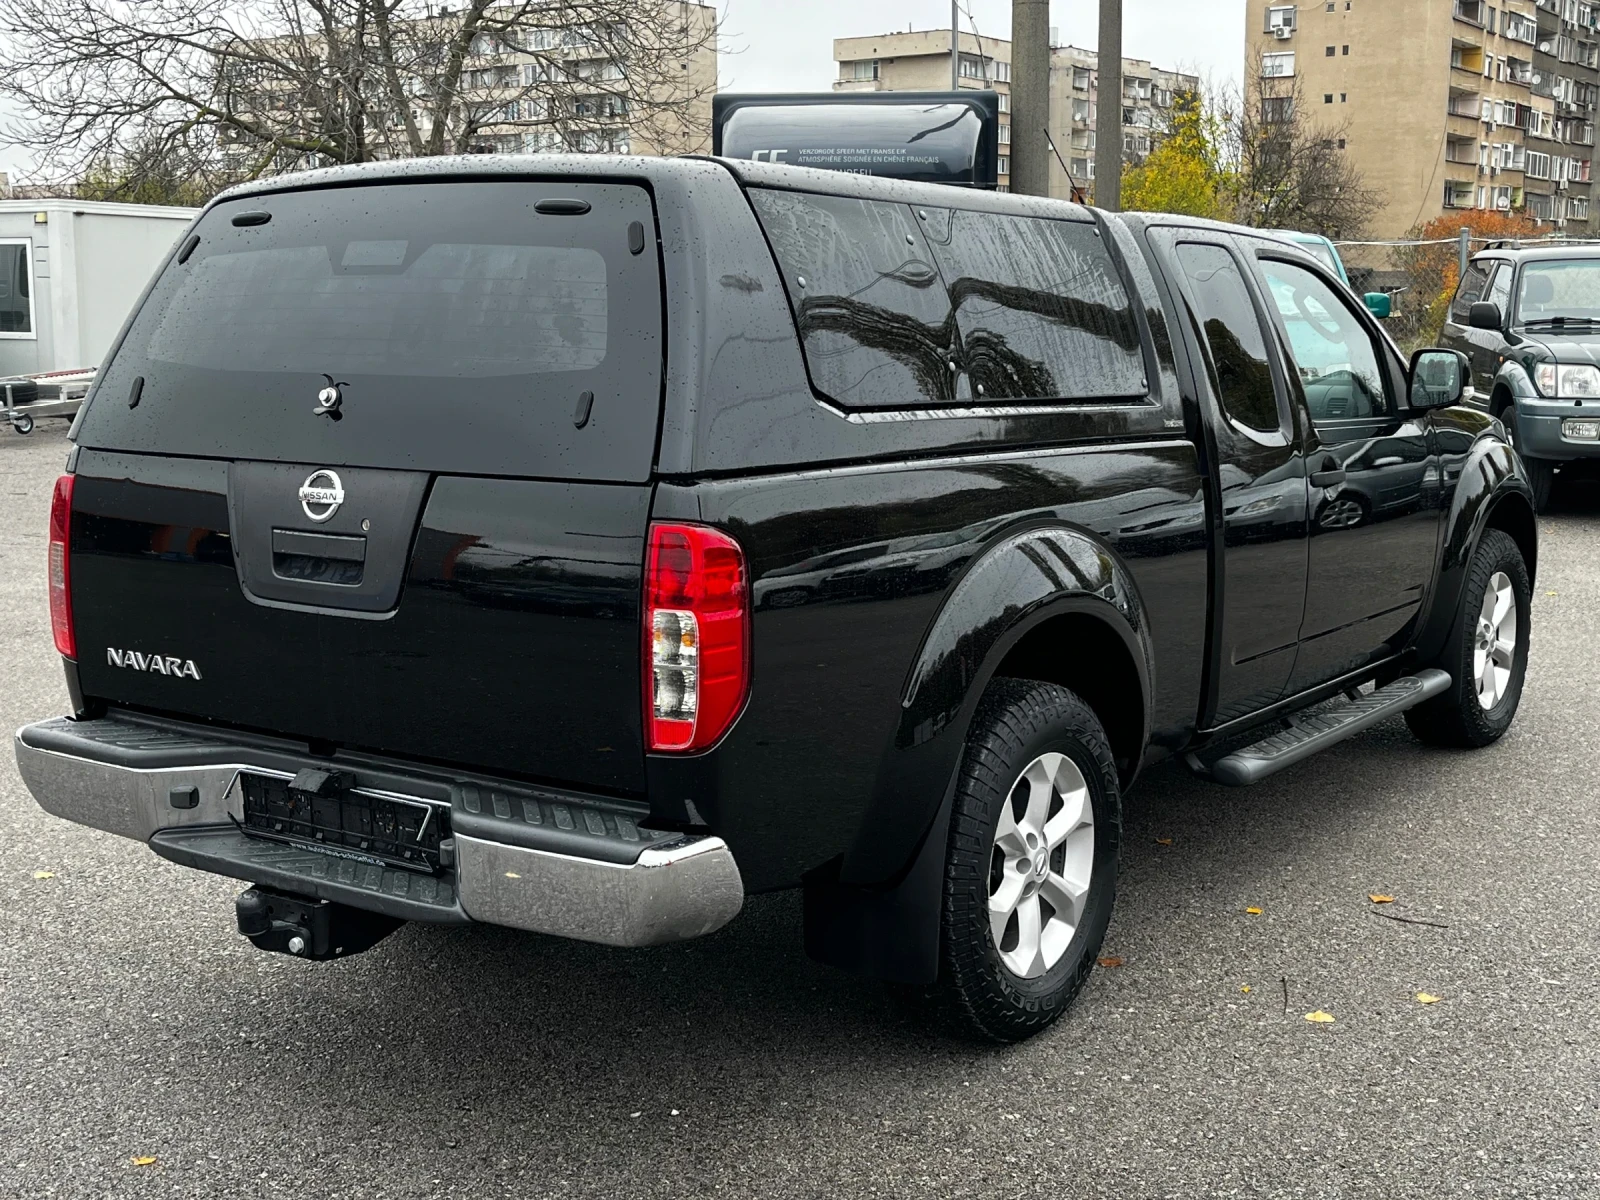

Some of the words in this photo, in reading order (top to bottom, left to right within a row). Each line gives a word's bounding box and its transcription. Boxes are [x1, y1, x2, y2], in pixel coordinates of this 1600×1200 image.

[843, 155, 872, 163] SOIGNÉE
[883, 155, 905, 163] CHÊNE
[906, 156, 939, 164] FRANÇAIS
[301, 490, 338, 501] NISSAN
[107, 647, 203, 680] NAVARA
